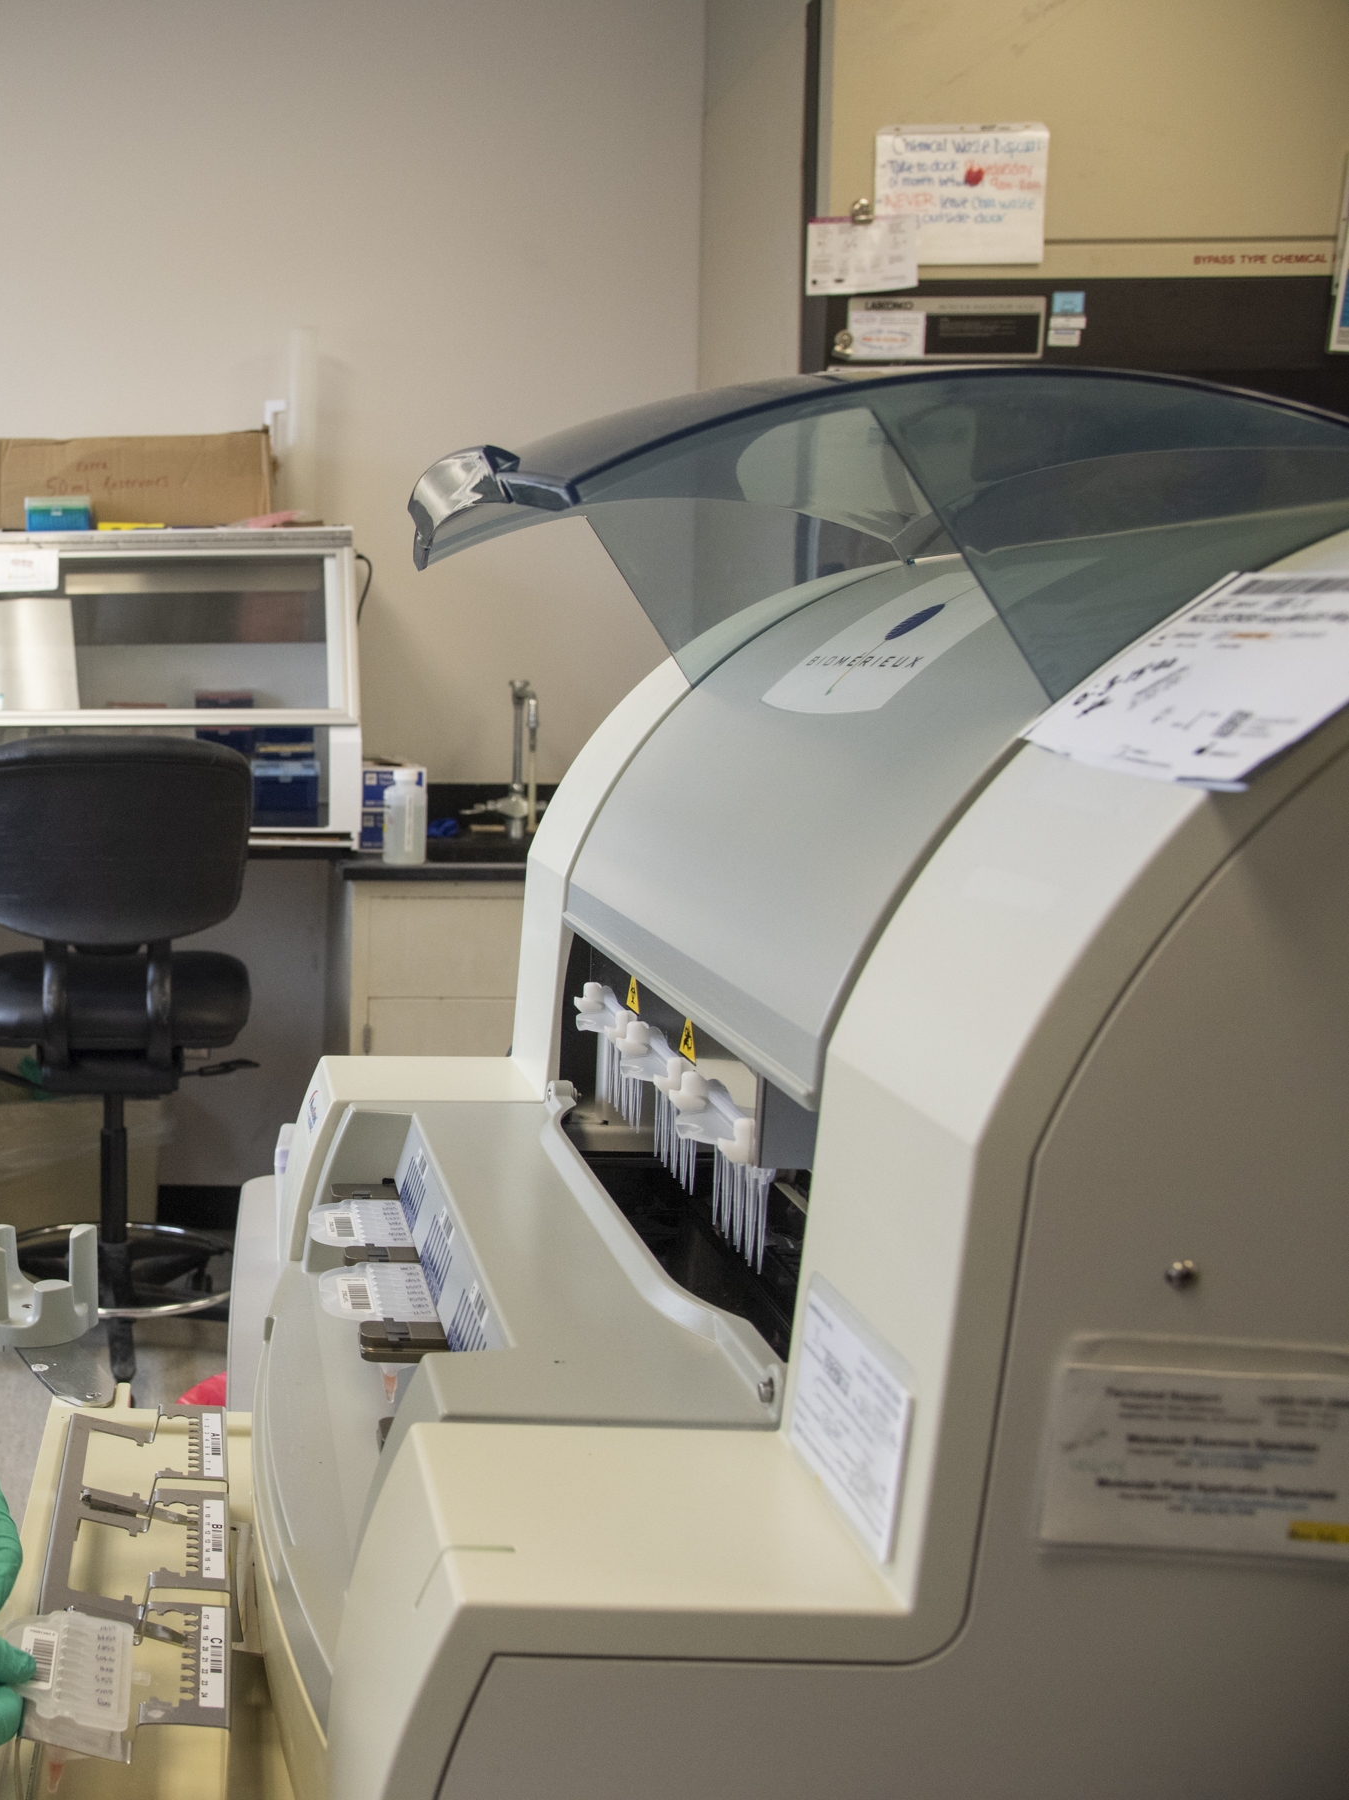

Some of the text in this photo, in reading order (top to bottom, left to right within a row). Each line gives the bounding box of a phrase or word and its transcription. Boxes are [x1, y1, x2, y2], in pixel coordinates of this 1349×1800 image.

[1193, 254, 1235, 265] BYPASS
[1240, 254, 1267, 264] TYPE
[1271, 253, 1328, 264] CHEMICAL
